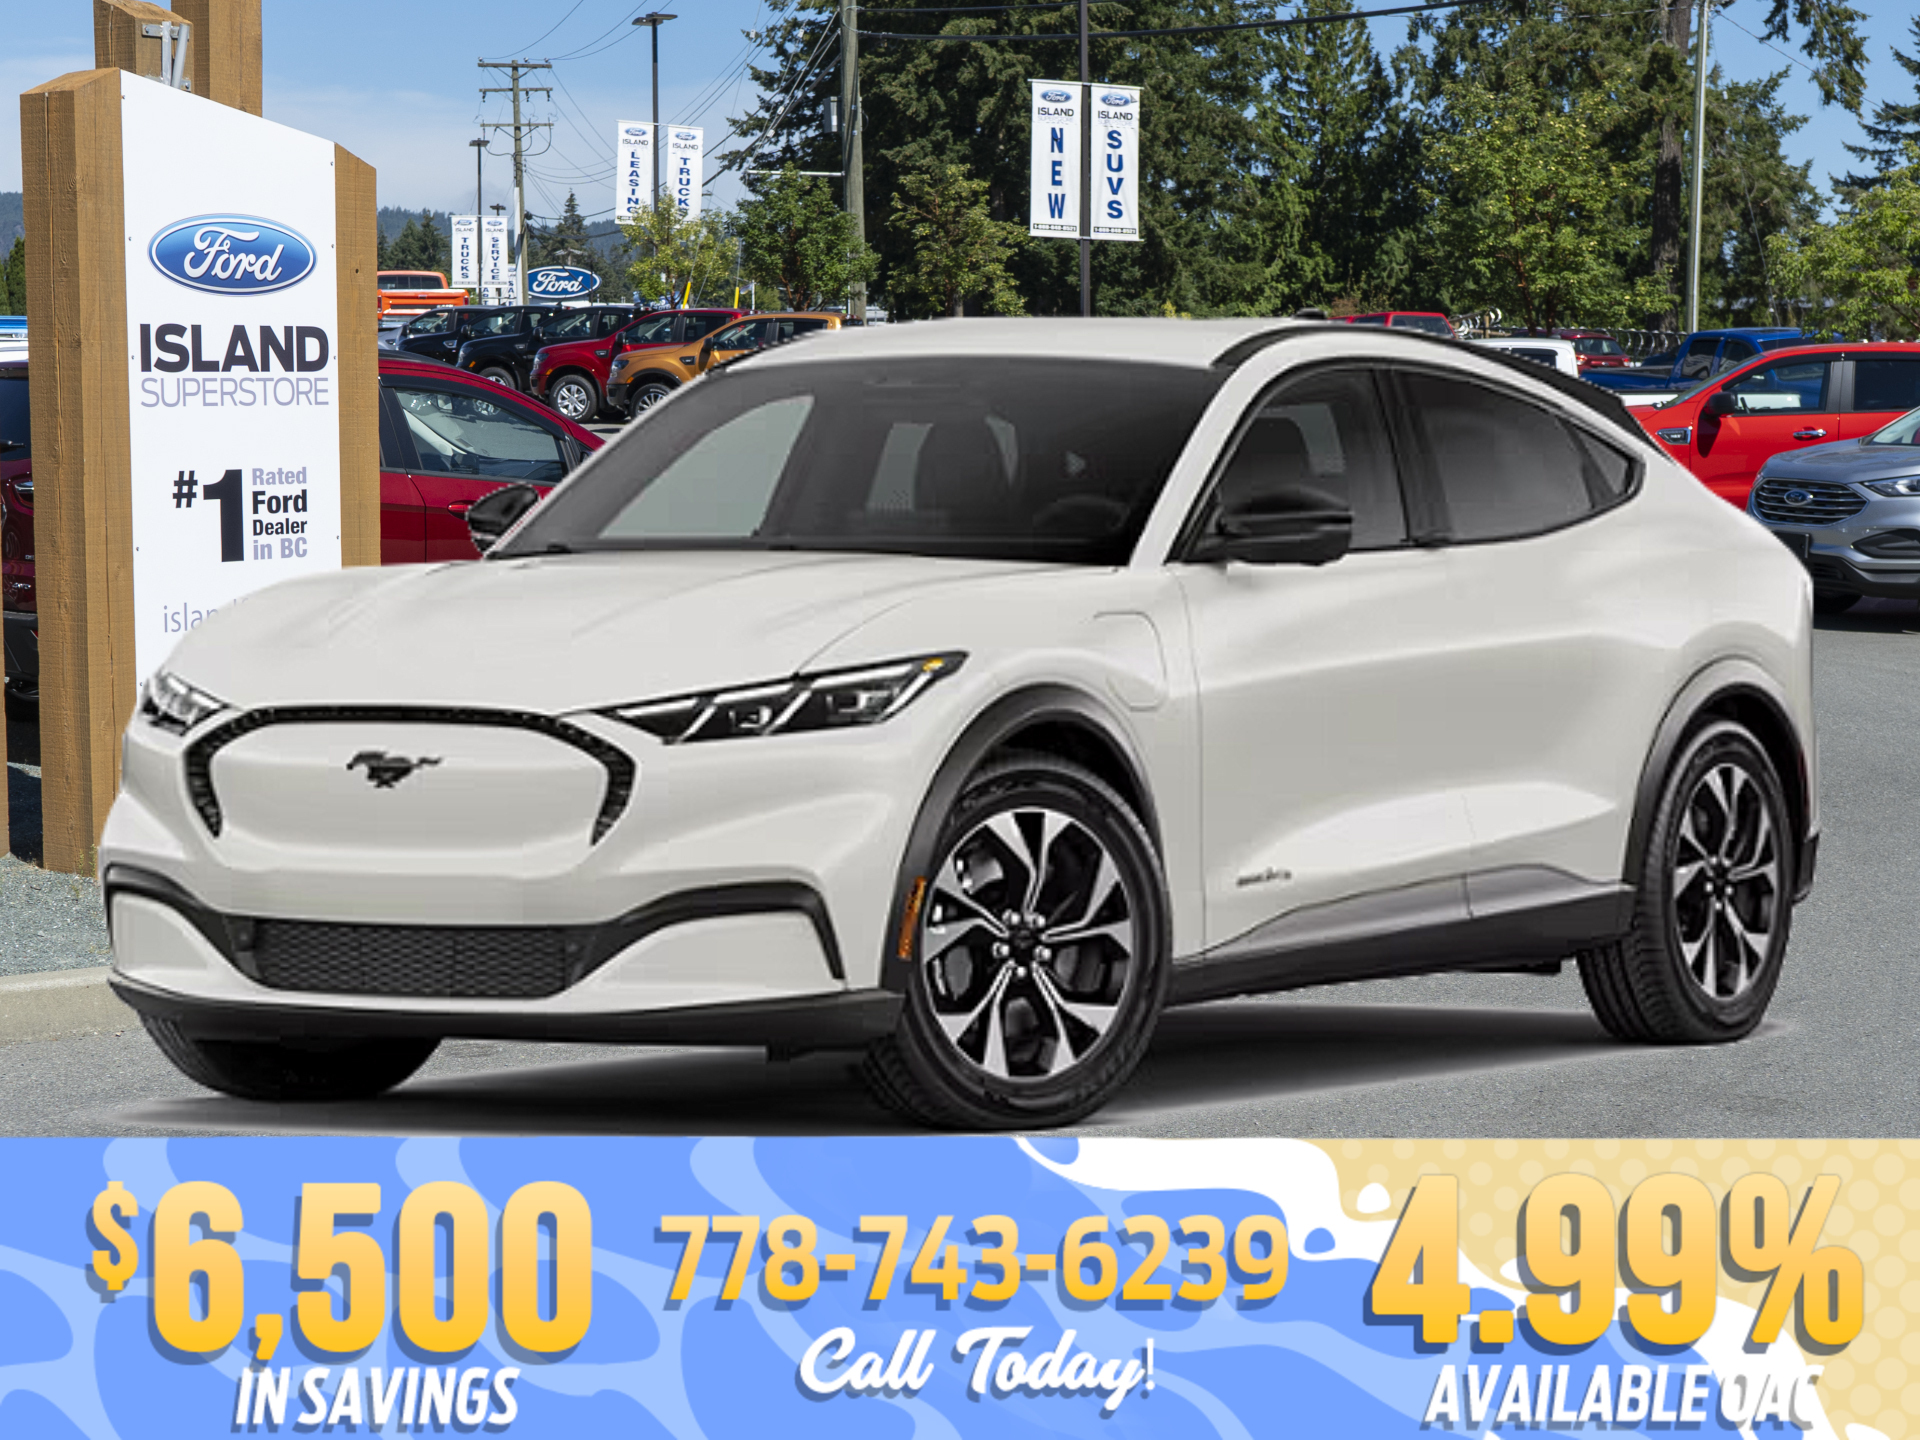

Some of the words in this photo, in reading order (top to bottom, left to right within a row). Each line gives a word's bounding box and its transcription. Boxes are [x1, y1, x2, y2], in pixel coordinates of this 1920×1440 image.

[1045, 91, 1067, 102] Ford
[1105, 95, 1126, 105] Ford
[1037, 107, 1075, 117] ISLAND
[1097, 110, 1133, 120] ISLAND
[622, 138, 648, 146] ISLAND
[672, 142, 698, 150] ISLAND
[627, 151, 640, 214] LEASING
[1048, 127, 1066, 219] NEW
[1106, 129, 1124, 219] SUVS
[678, 157, 690, 217] TRUCKS
[184, 226, 285, 281] Ford
[461, 237, 469, 279] TRUCKS
[491, 236, 500, 280] SERVICE
[532, 270, 583, 293] Ford
[140, 323, 329, 373] ISLAND
[140, 377, 329, 407] SUPERSTORE
[252, 466, 307, 485] Rated
[252, 489, 308, 514] Ford
[172, 469, 244, 562] #1
[252, 518, 308, 536] Dealer
[253, 539, 272, 560] in
[280, 537, 308, 559] BC
